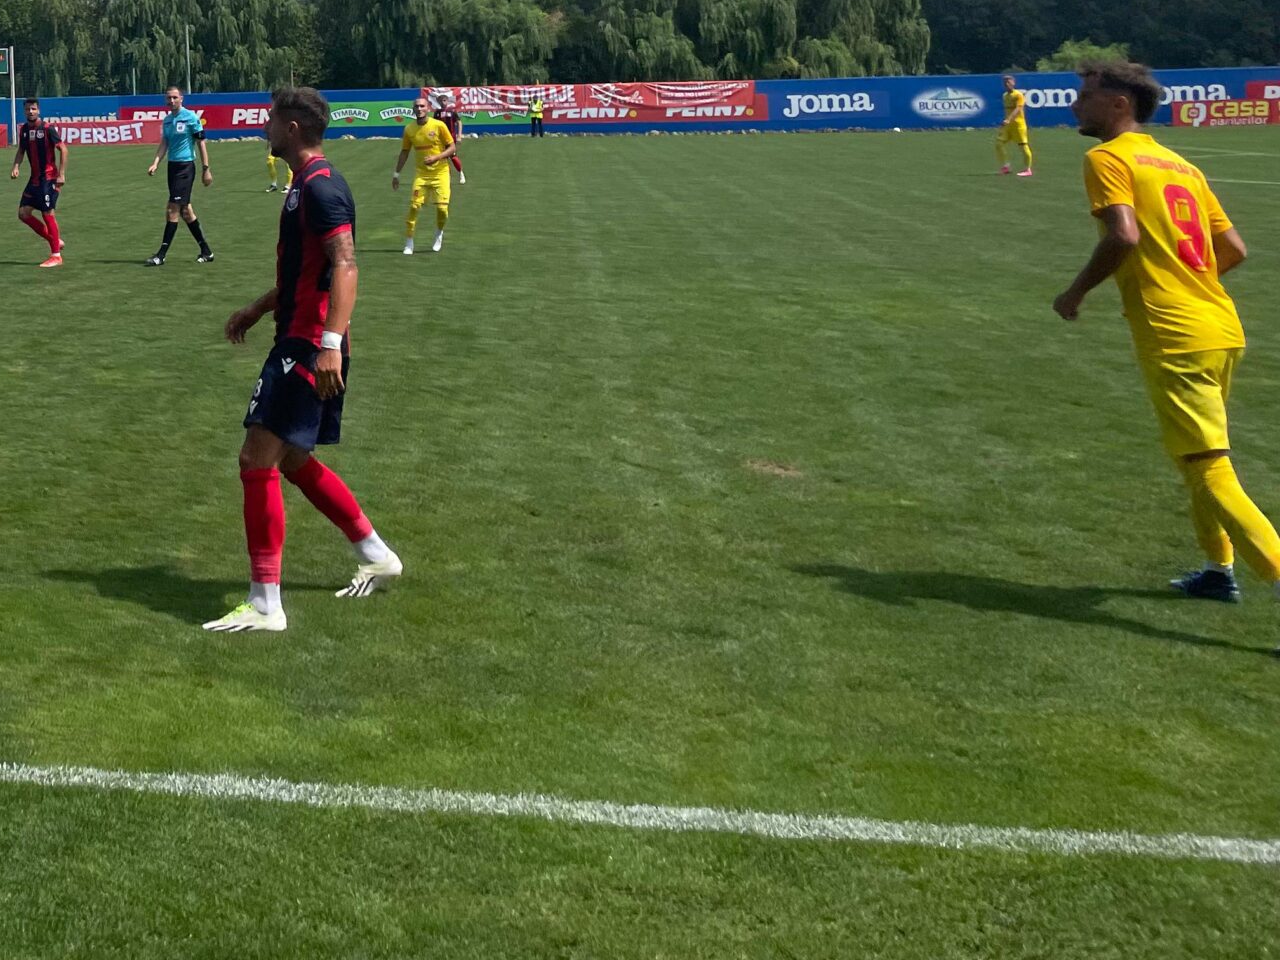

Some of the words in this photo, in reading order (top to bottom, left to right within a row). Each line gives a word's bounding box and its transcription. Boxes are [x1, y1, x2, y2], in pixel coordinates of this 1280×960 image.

[333, 108, 368, 119] TYMBARK
[919, 101, 980, 111] BUCOVINA
[1210, 101, 1270, 117] casa
[55, 122, 144, 144] UPERBET
[1163, 184, 1209, 272] 9
